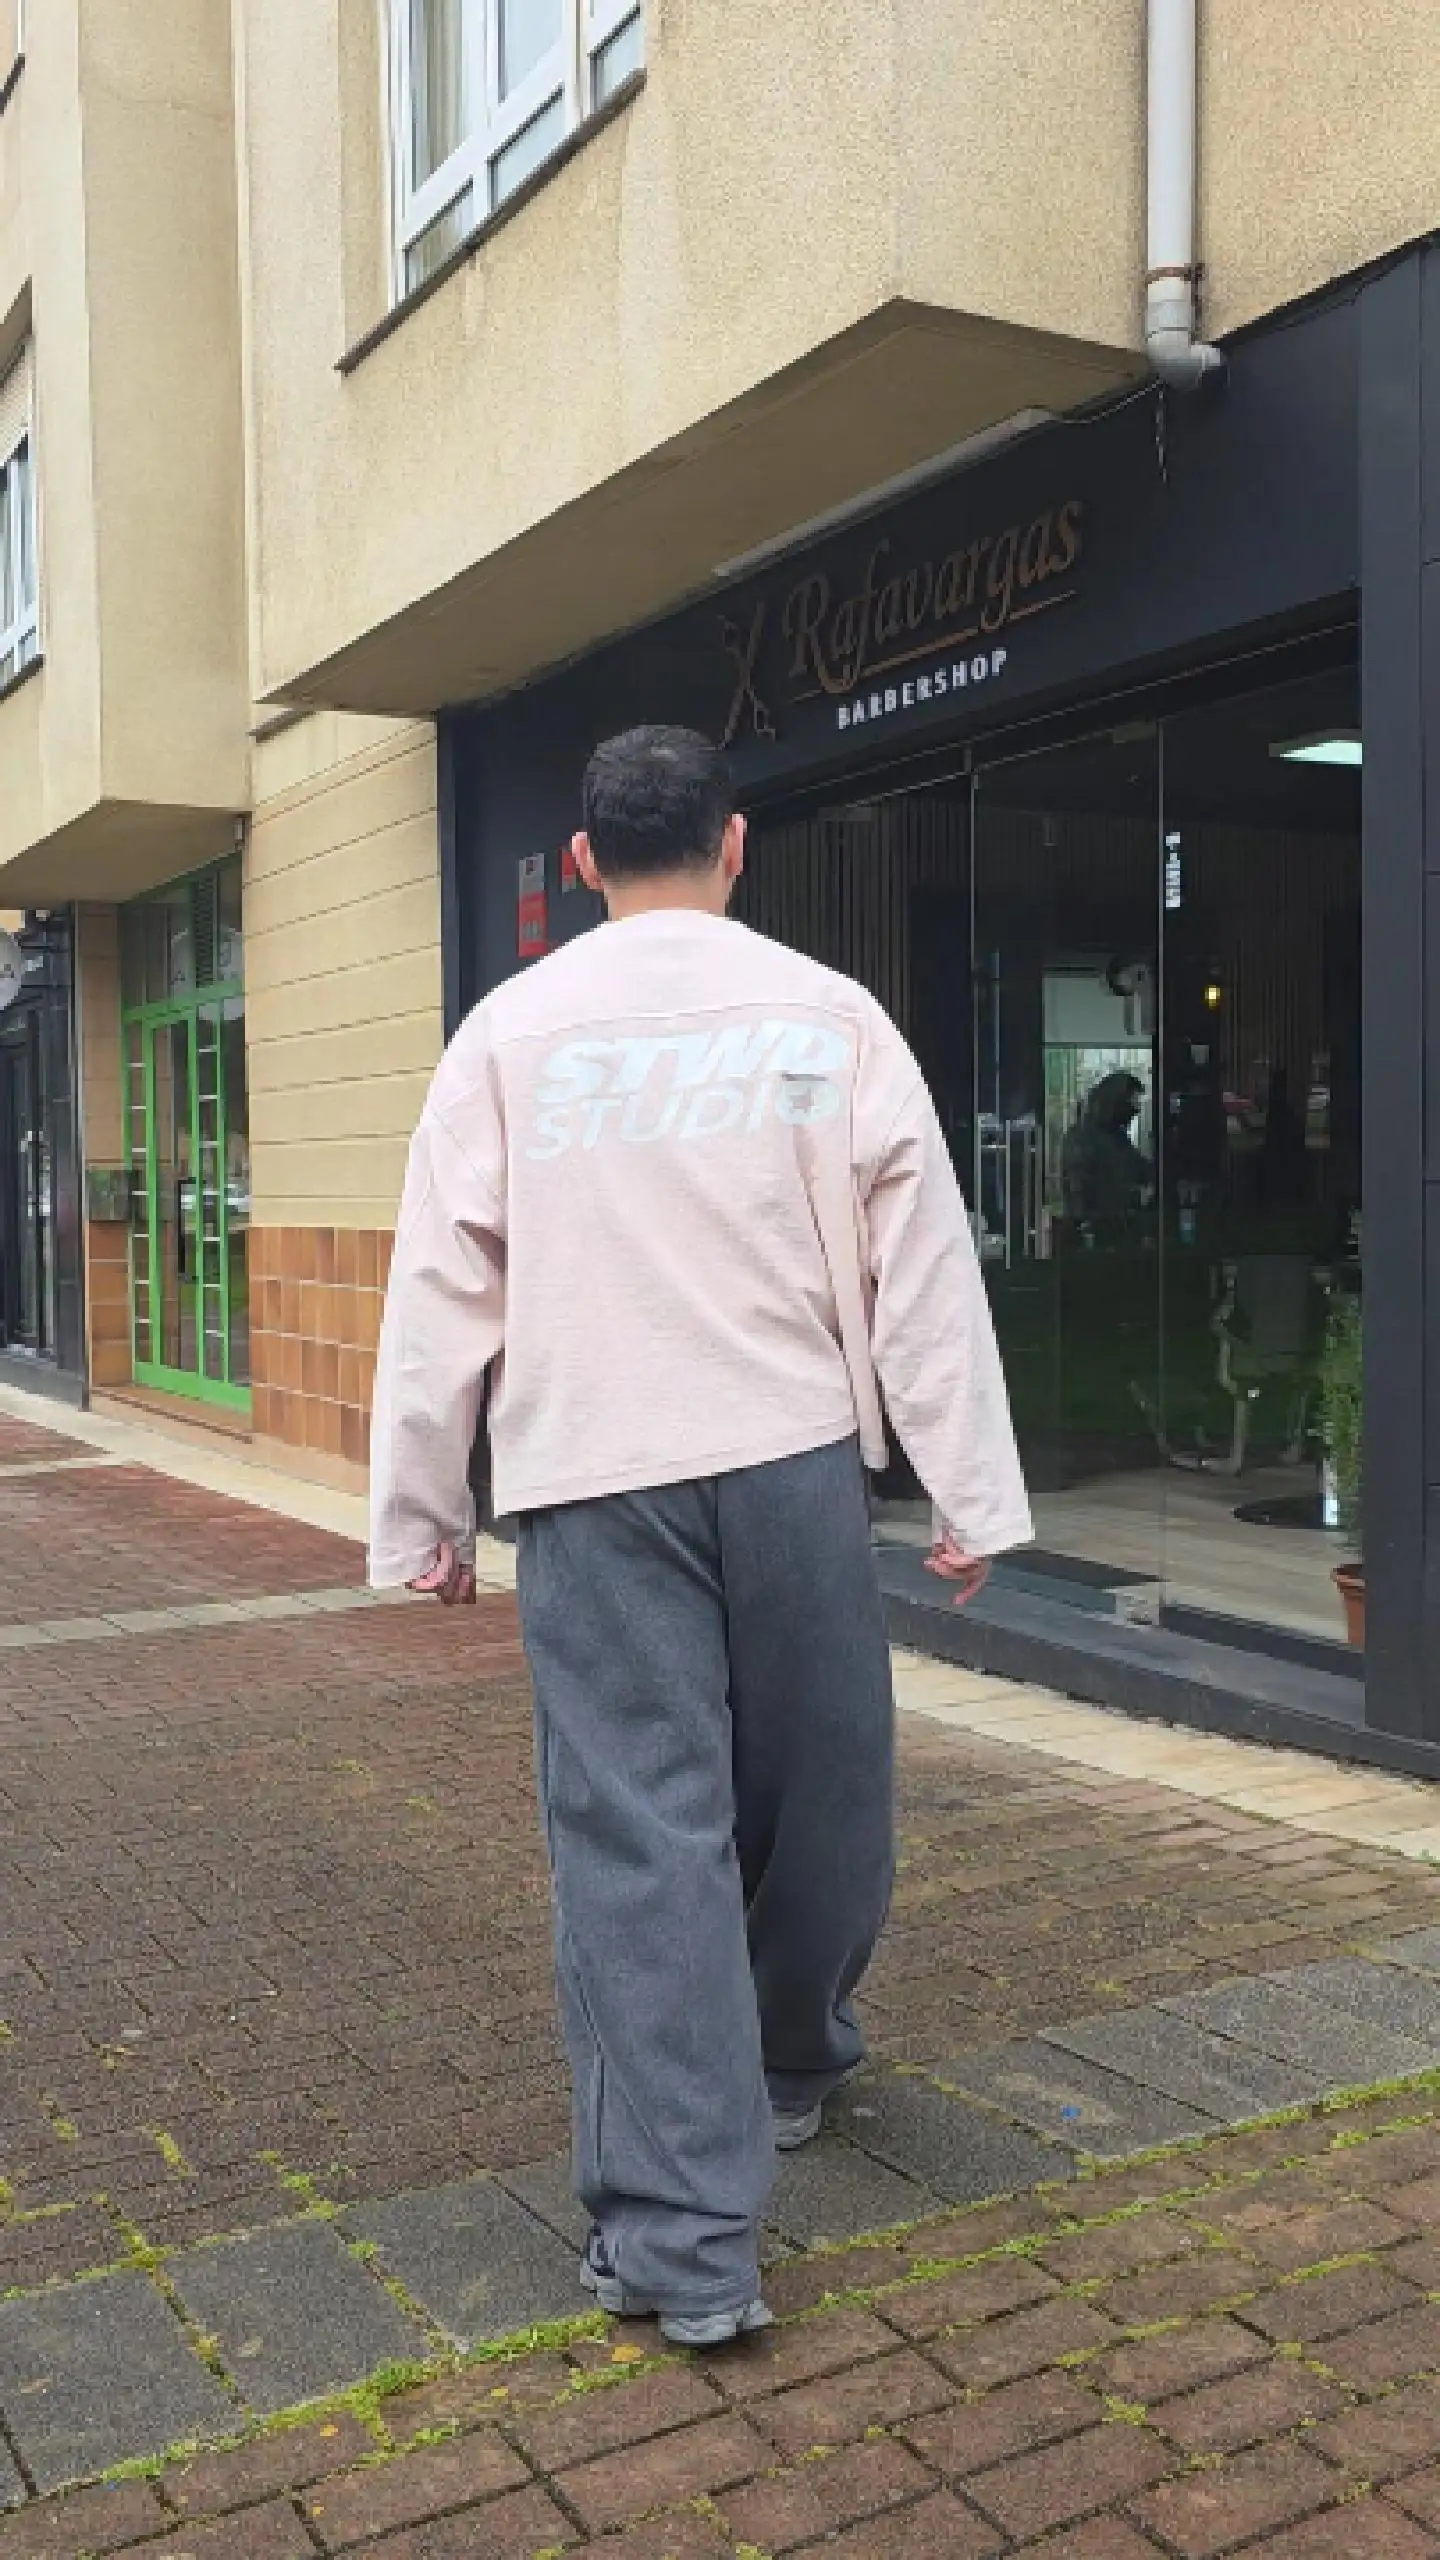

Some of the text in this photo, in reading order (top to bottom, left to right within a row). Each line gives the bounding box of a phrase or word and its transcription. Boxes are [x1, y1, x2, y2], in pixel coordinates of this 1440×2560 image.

[782, 500, 1083, 694] Rafavargas
[837, 646, 1008, 730] BARBERSHOP
[534, 1019, 850, 1102] STWD
[525, 1078, 841, 1160] STUDIO
